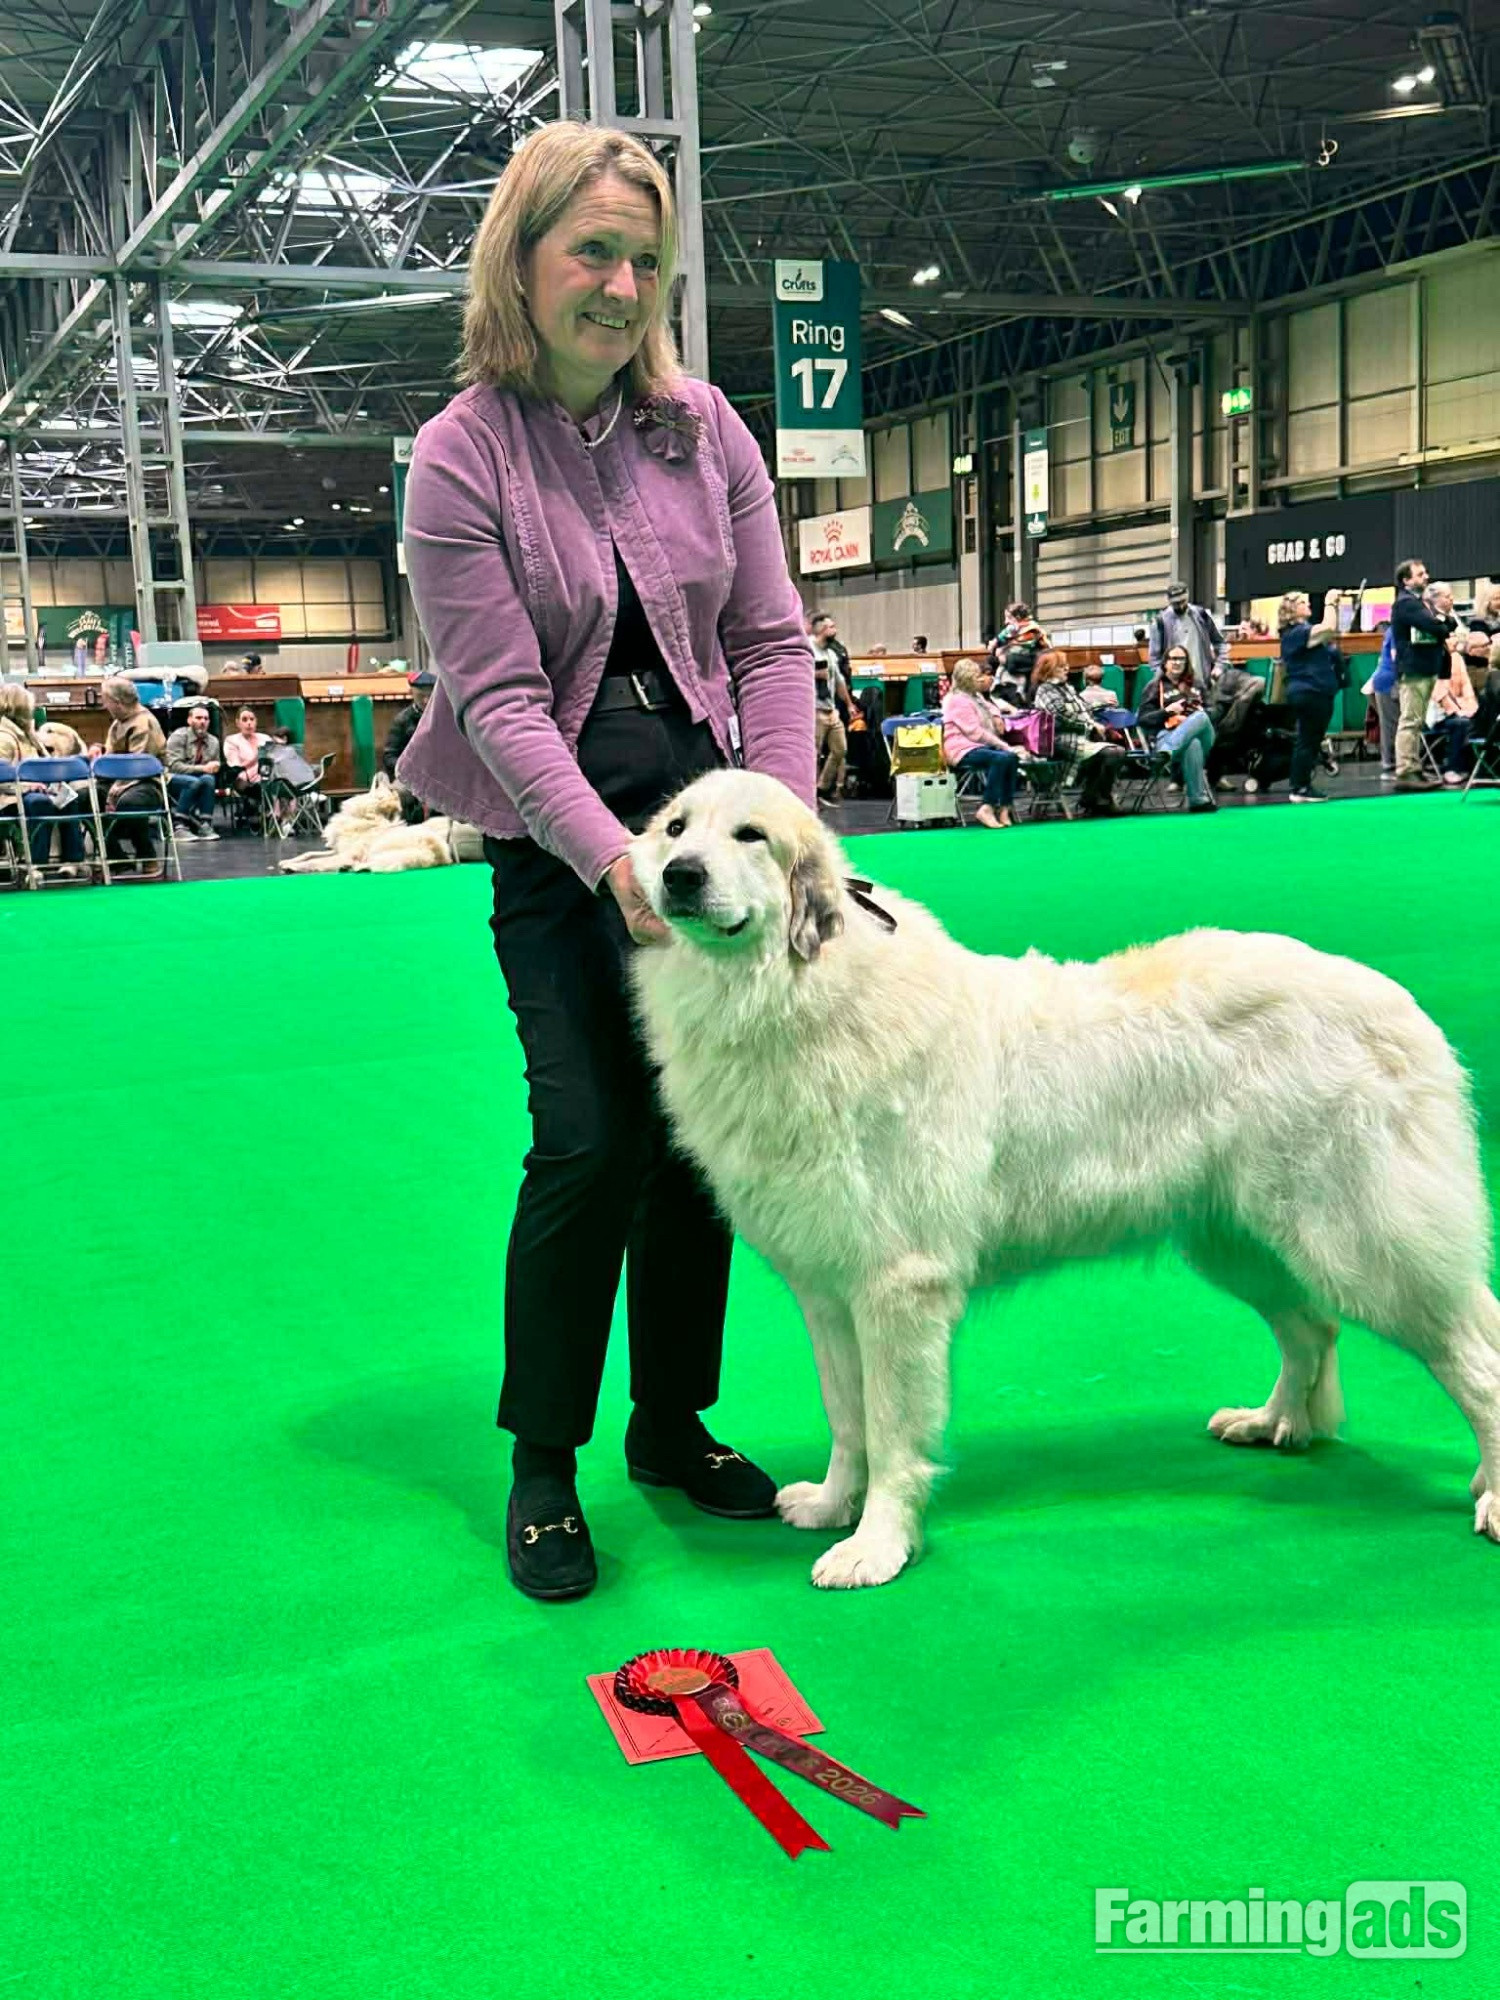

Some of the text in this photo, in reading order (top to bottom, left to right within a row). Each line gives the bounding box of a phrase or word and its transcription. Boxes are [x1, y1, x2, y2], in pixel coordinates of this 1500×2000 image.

[782, 279, 816, 291] Crufts
[792, 319, 845, 352] Ring
[791, 358, 848, 409] 17
[1268, 534, 1345, 564] GRAB & GO
[814, 1768, 884, 1805] 2026
